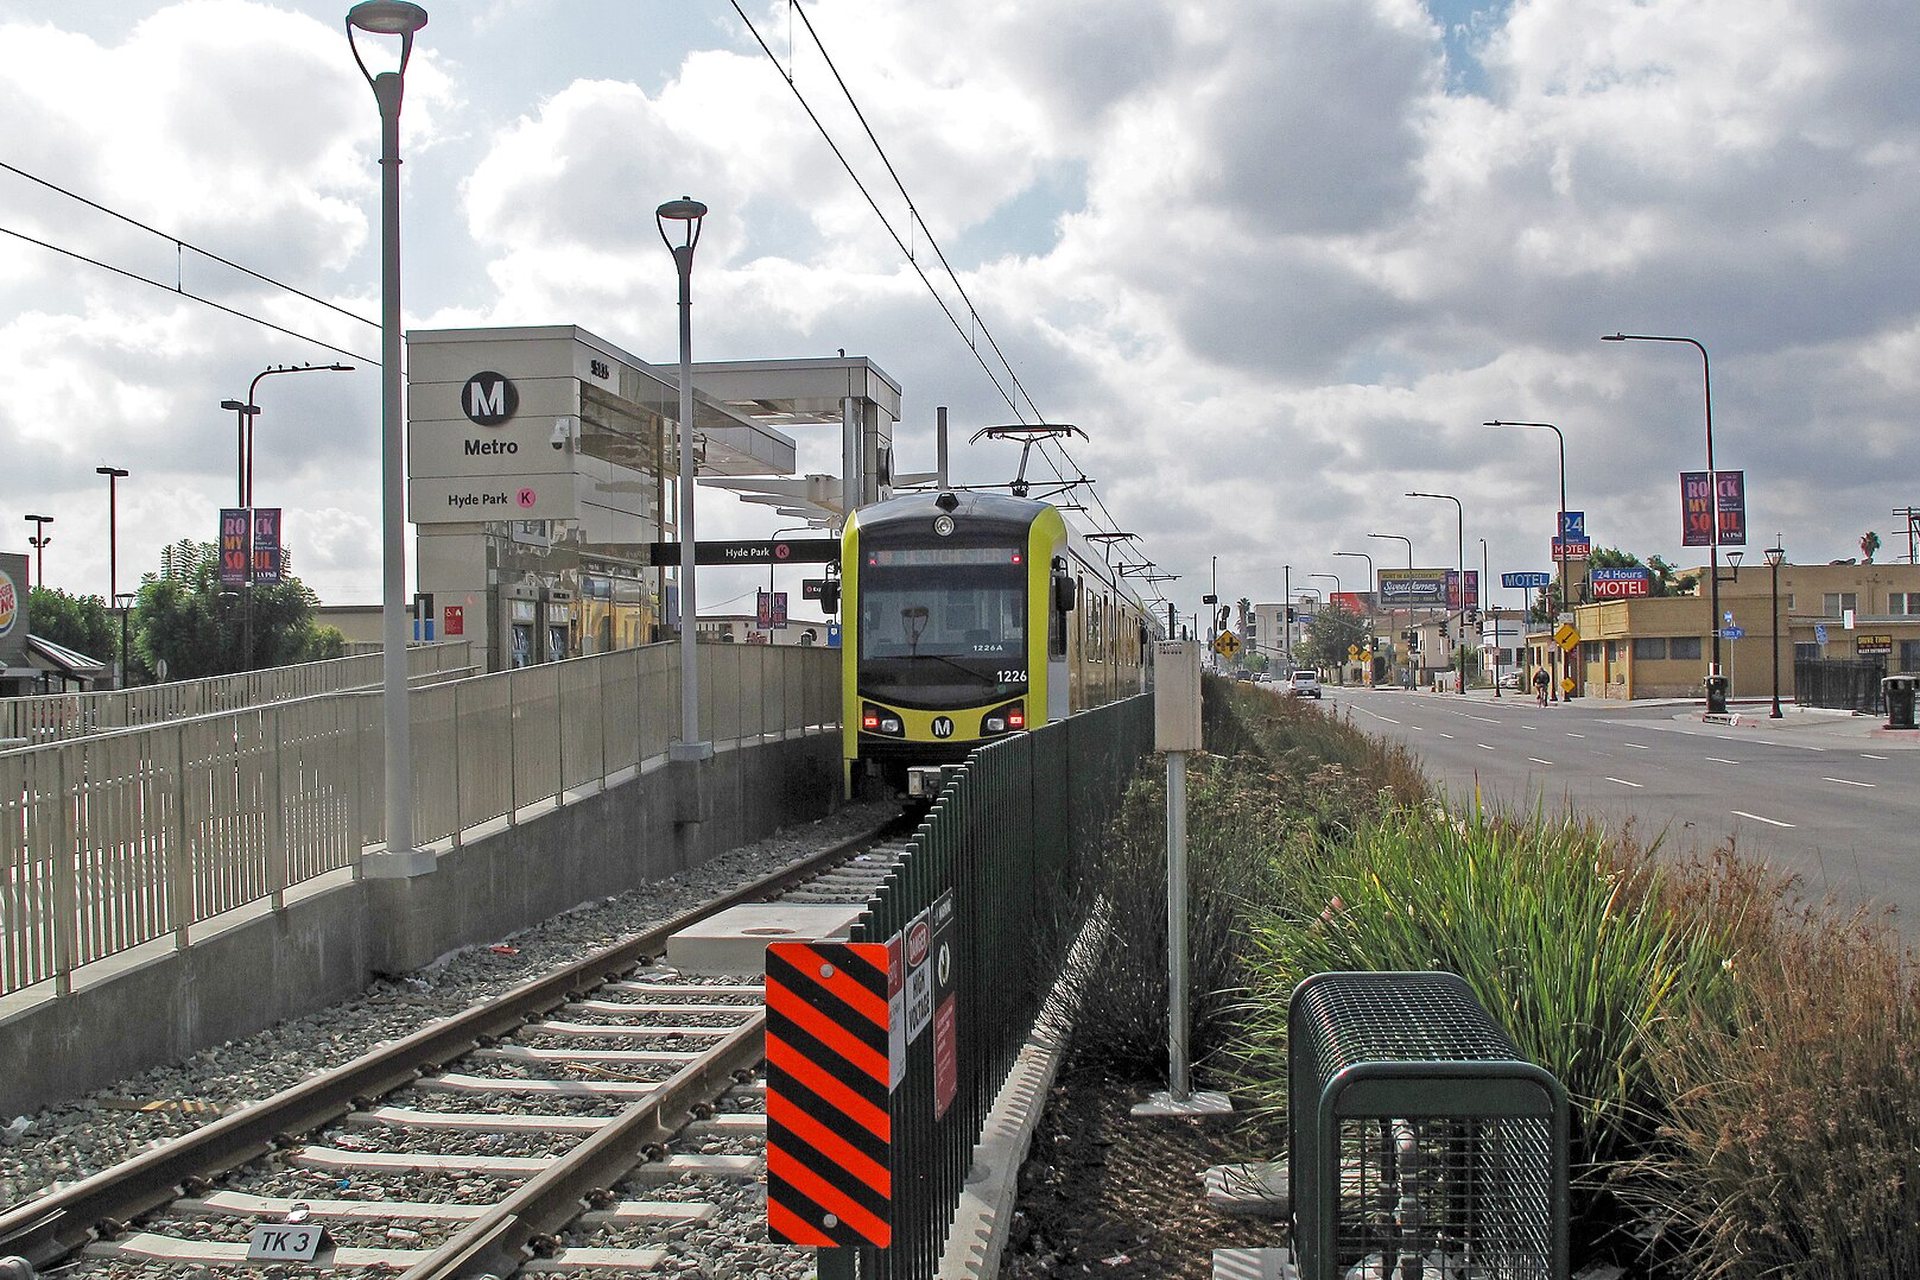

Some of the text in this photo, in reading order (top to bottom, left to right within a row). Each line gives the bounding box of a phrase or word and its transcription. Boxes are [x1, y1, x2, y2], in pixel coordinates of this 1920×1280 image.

[471, 381, 504, 416] M
[464, 439, 519, 455] Metro
[448, 491, 531, 508] Hyde Park K
[225, 518, 273, 535] RO CK
[725, 549, 748, 559] Hyde
[750, 547, 770, 557] Park
[1554, 544, 1588, 554] MOTEL
[1505, 574, 1548, 587] MOTEL
[1598, 570, 1643, 579] 24 Hours
[1593, 581, 1646, 596] MOTEL
[996, 670, 1027, 682] 1226
[935, 719, 951, 736] M
[262, 1231, 310, 1252] TK 3
